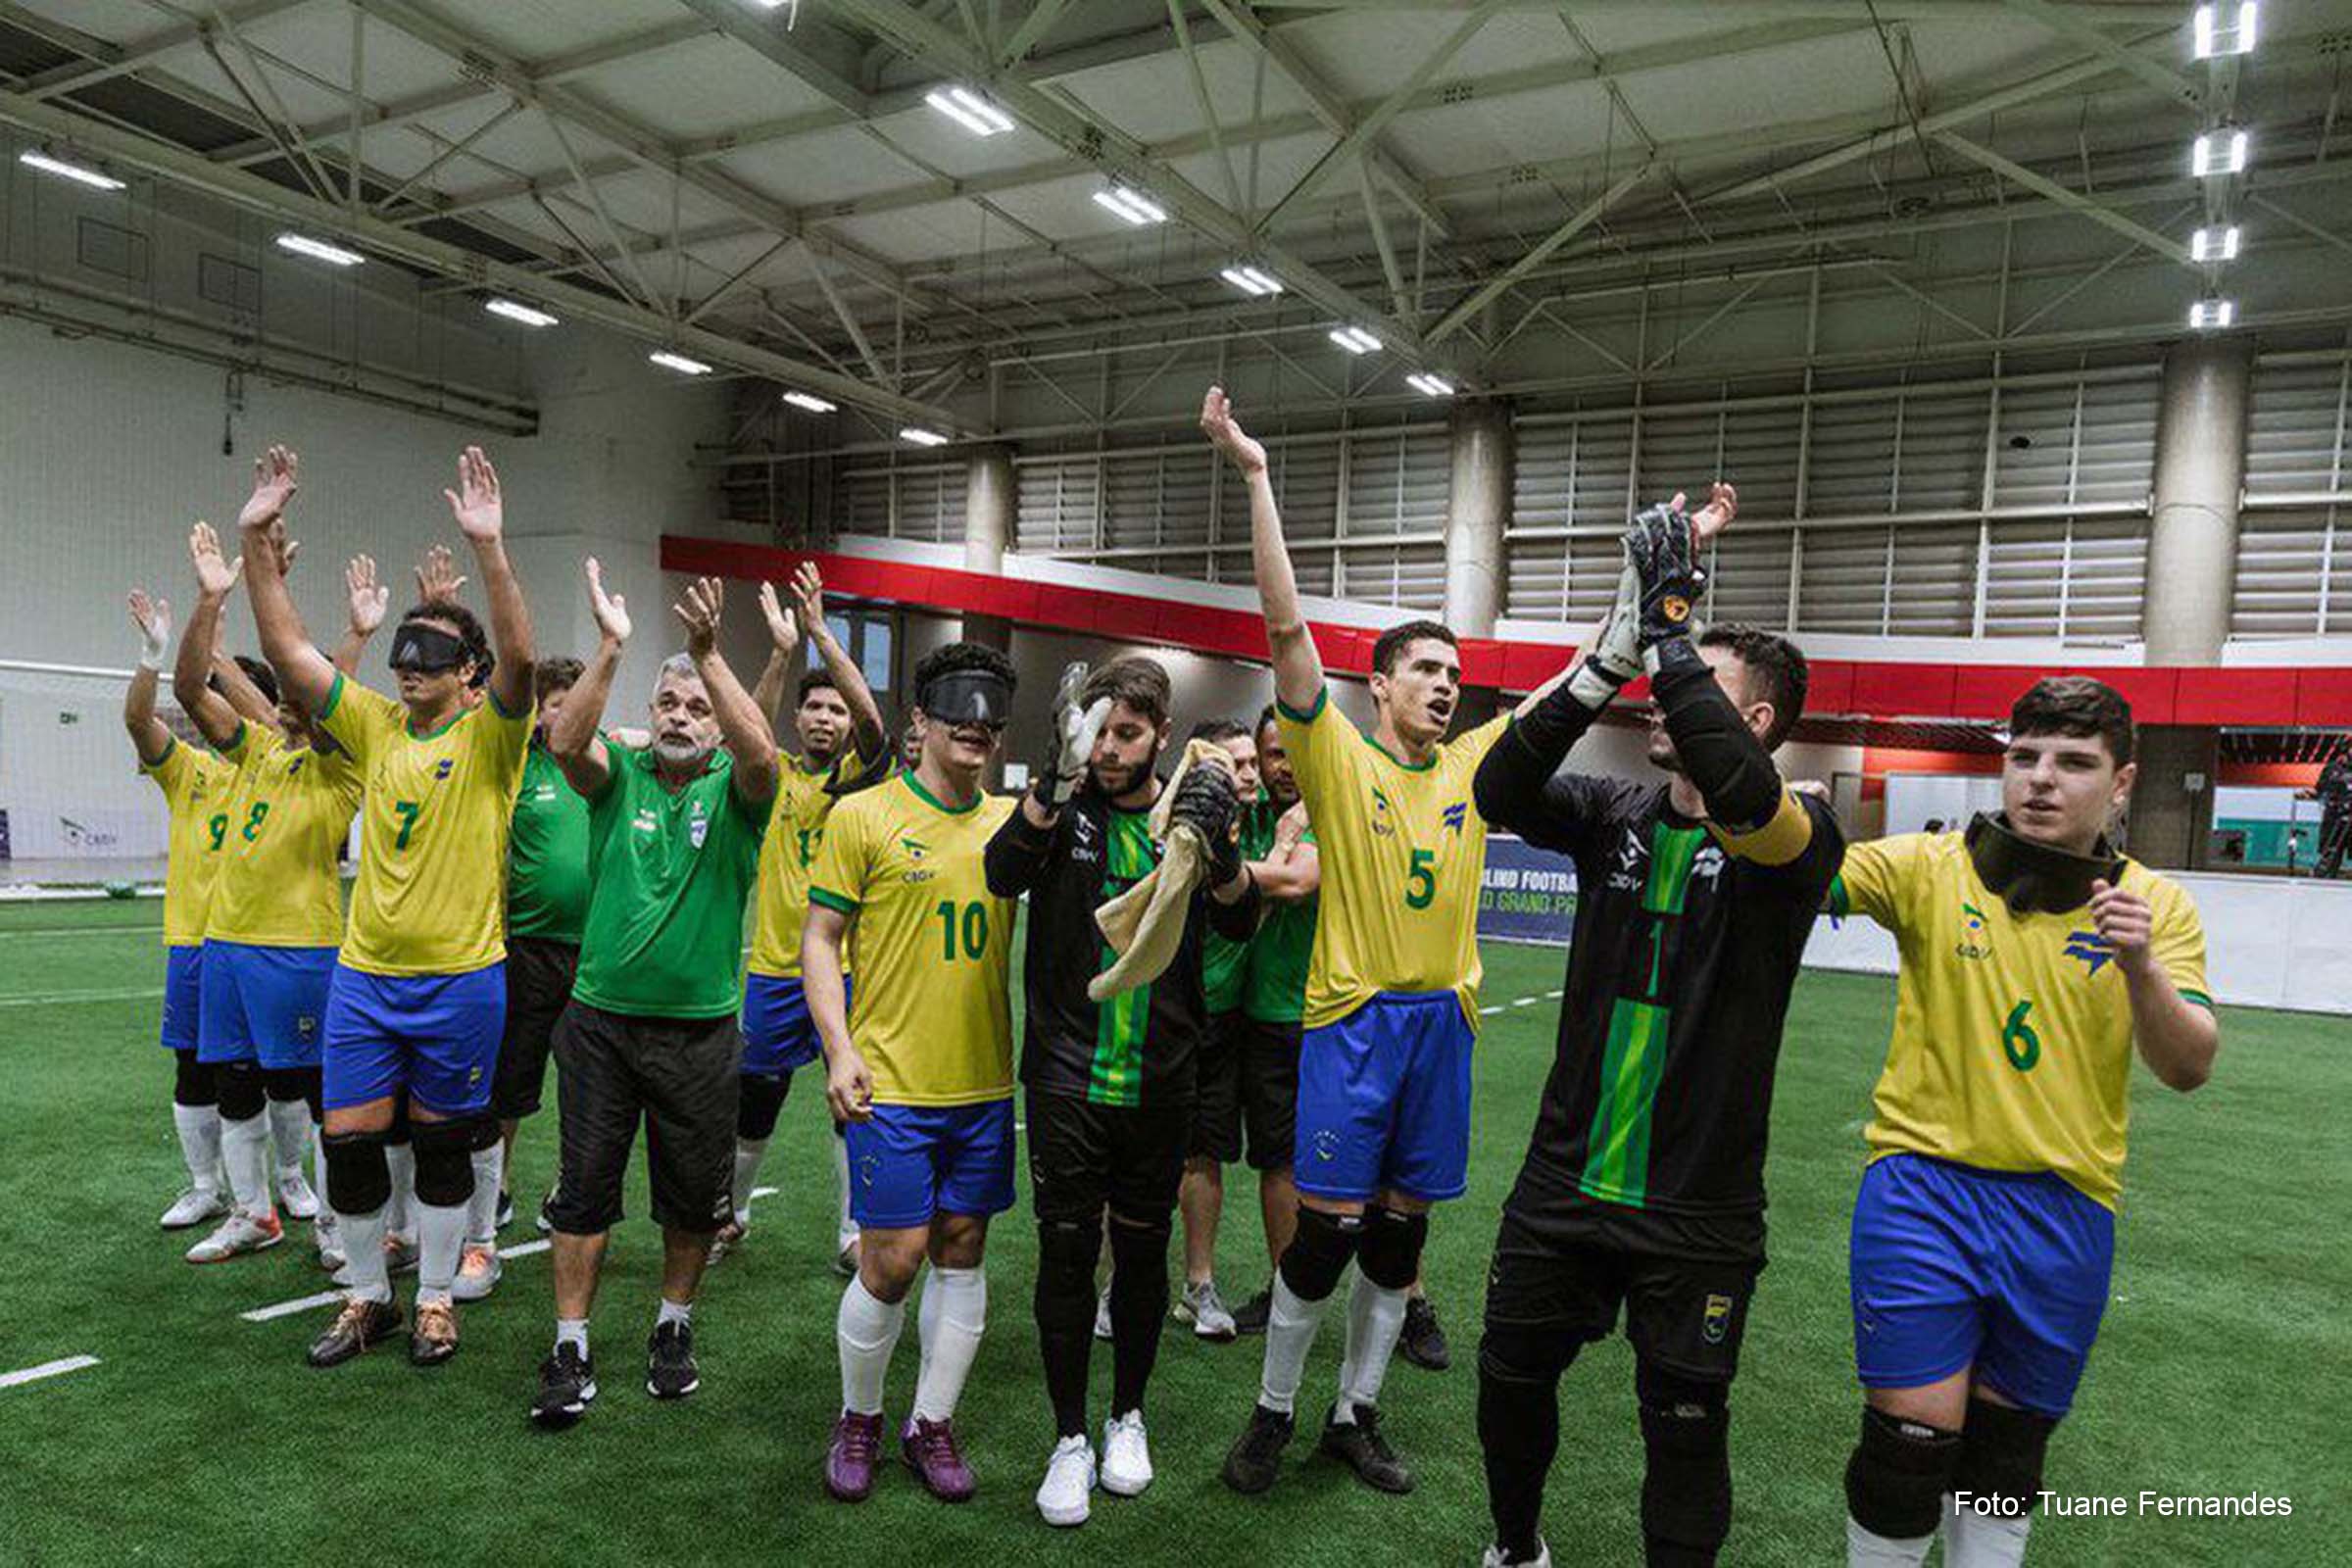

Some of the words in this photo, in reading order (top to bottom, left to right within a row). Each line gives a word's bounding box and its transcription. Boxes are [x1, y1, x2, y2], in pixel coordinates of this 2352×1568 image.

[210, 813, 228, 852] 9
[242, 801, 270, 843] 8
[395, 800, 418, 850] 7
[1405, 849, 1436, 909] 5
[1497, 891, 1550, 914] GRAND
[936, 900, 988, 961] 10
[1646, 919, 1664, 998] 1
[2002, 1000, 2040, 1071] 6
